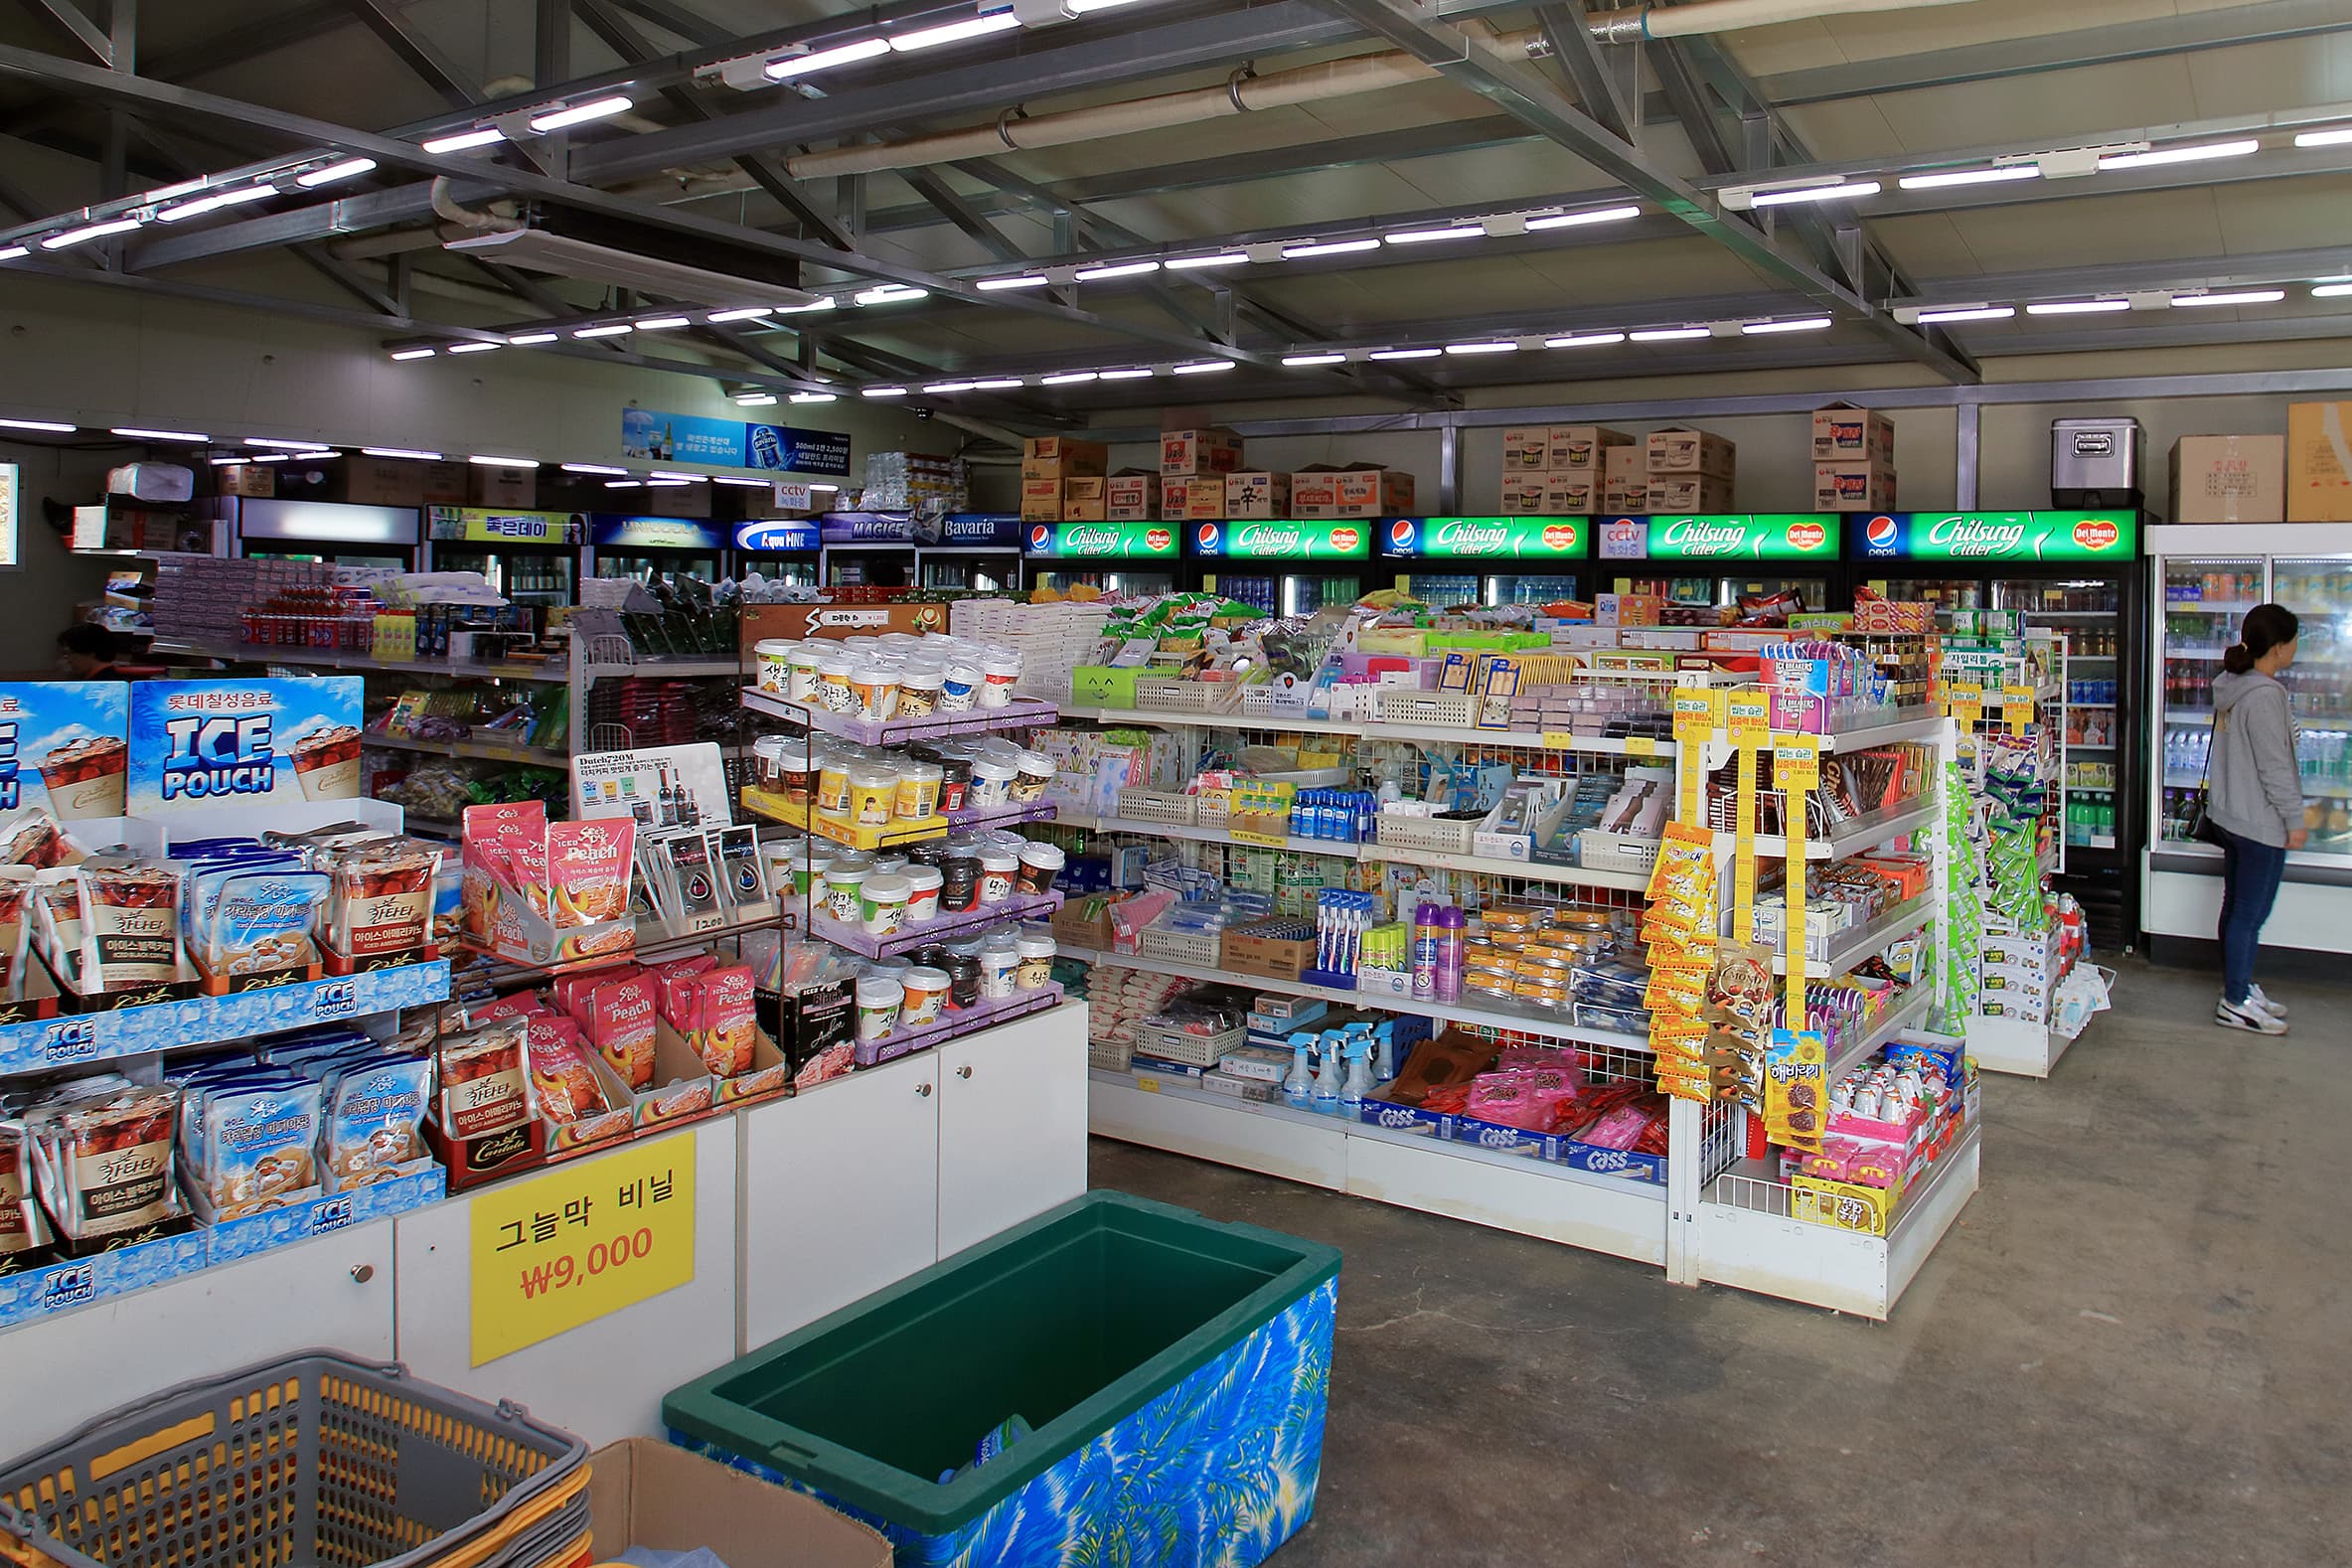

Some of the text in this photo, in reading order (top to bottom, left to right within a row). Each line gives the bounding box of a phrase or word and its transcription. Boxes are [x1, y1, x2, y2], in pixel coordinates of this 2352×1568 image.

[781, 484, 807, 496] cctv
[1240, 485, 1258, 512] 辛
[945, 518, 995, 537] Bavaria
[1437, 521, 1508, 550] Chilsung
[1544, 531, 1554, 540] Del
[1607, 527, 1641, 542] cctv
[1664, 519, 1746, 550] Chilsung
[1789, 528, 1800, 539] Del
[1929, 516, 2025, 552] Chilsung
[2076, 528, 2089, 540] Del
[761, 532, 785, 549] Aqua
[1066, 525, 1120, 551] Chilsung
[1238, 524, 1300, 551] Chilsung
[1332, 534, 1340, 543] Del
[1031, 548, 1049, 556] pepsi
[1077, 545, 1106, 556] Cider
[1251, 545, 1281, 556] Cider
[1452, 544, 1485, 555] Cider
[1607, 543, 1639, 557] 녹화중
[1681, 543, 1720, 557] Cider
[1868, 548, 1897, 557] pepsi
[1950, 544, 1993, 556] Cider
[1775, 661, 1813, 674] ICE BREAKERS
[1951, 654, 1987, 665] 자일리톨
[167, 692, 273, 710] 롯데칠성음료
[1691, 702, 1706, 711] 습관
[1731, 706, 1763, 716] 씹는 습관
[164, 715, 273, 770] ICE
[579, 753, 634, 766] Dutch720M
[1778, 748, 1811, 759] 씹는 습관
[580, 766, 610, 777] 더치커피
[610, 764, 633, 774] 맛있게
[633, 762, 653, 772] 즐기는
[163, 768, 275, 800] POUCH
[522, 856, 547, 867] Pea
[567, 846, 617, 862] Peach
[947, 884, 963, 896] 88
[368, 903, 414, 925] 칸타타
[113, 911, 165, 934] 칸타타
[696, 917, 723, 930] 1200
[497, 921, 524, 942] Peach
[381, 936, 415, 948] AMERICANO
[317, 980, 356, 1006] ICE
[813, 990, 843, 1006] Black
[316, 1000, 357, 1018] POUCH
[611, 998, 651, 1022] Peach
[48, 1019, 95, 1045] ICE
[46, 1040, 96, 1060] POUCH
[1771, 1063, 1820, 1084] 해바라기
[465, 1082, 511, 1107] 칸타타
[483, 1112, 517, 1127] AMERICANO
[98, 1156, 157, 1183] 칸타타
[312, 1196, 353, 1226] ICE
[495, 1169, 674, 1252] 그늘막 비닐
[312, 1215, 354, 1236] POUCH
[520, 1227, 653, 1300] ₩9,000
[47, 1262, 94, 1294] ICE
[44, 1286, 94, 1309] POUCH
